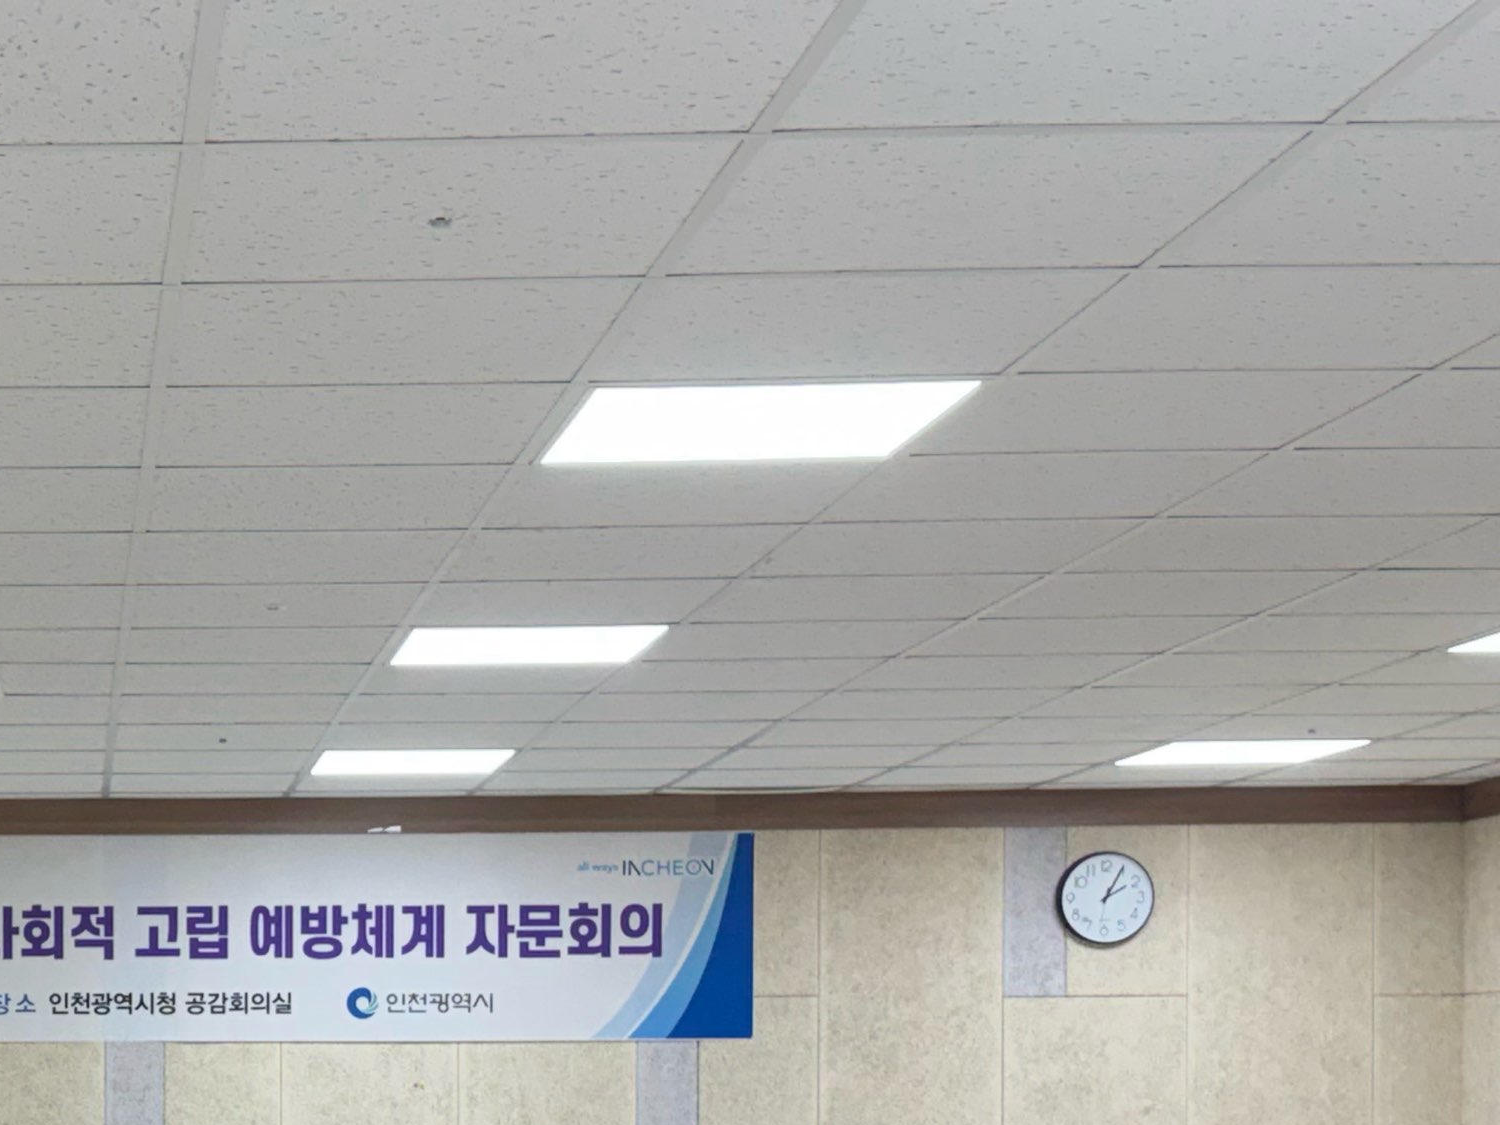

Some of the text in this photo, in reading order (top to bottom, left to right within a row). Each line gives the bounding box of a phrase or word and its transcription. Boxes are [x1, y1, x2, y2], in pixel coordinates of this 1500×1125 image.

[622, 859, 715, 876] INCHEON
[134, 904, 230, 959] 고립
[249, 903, 445, 959] 예방체계
[465, 902, 664, 958] 자문회의
[49, 992, 177, 1016] 인천광역시청
[185, 991, 292, 1016] 공감회의실
[386, 993, 494, 1013] 인천광역시
